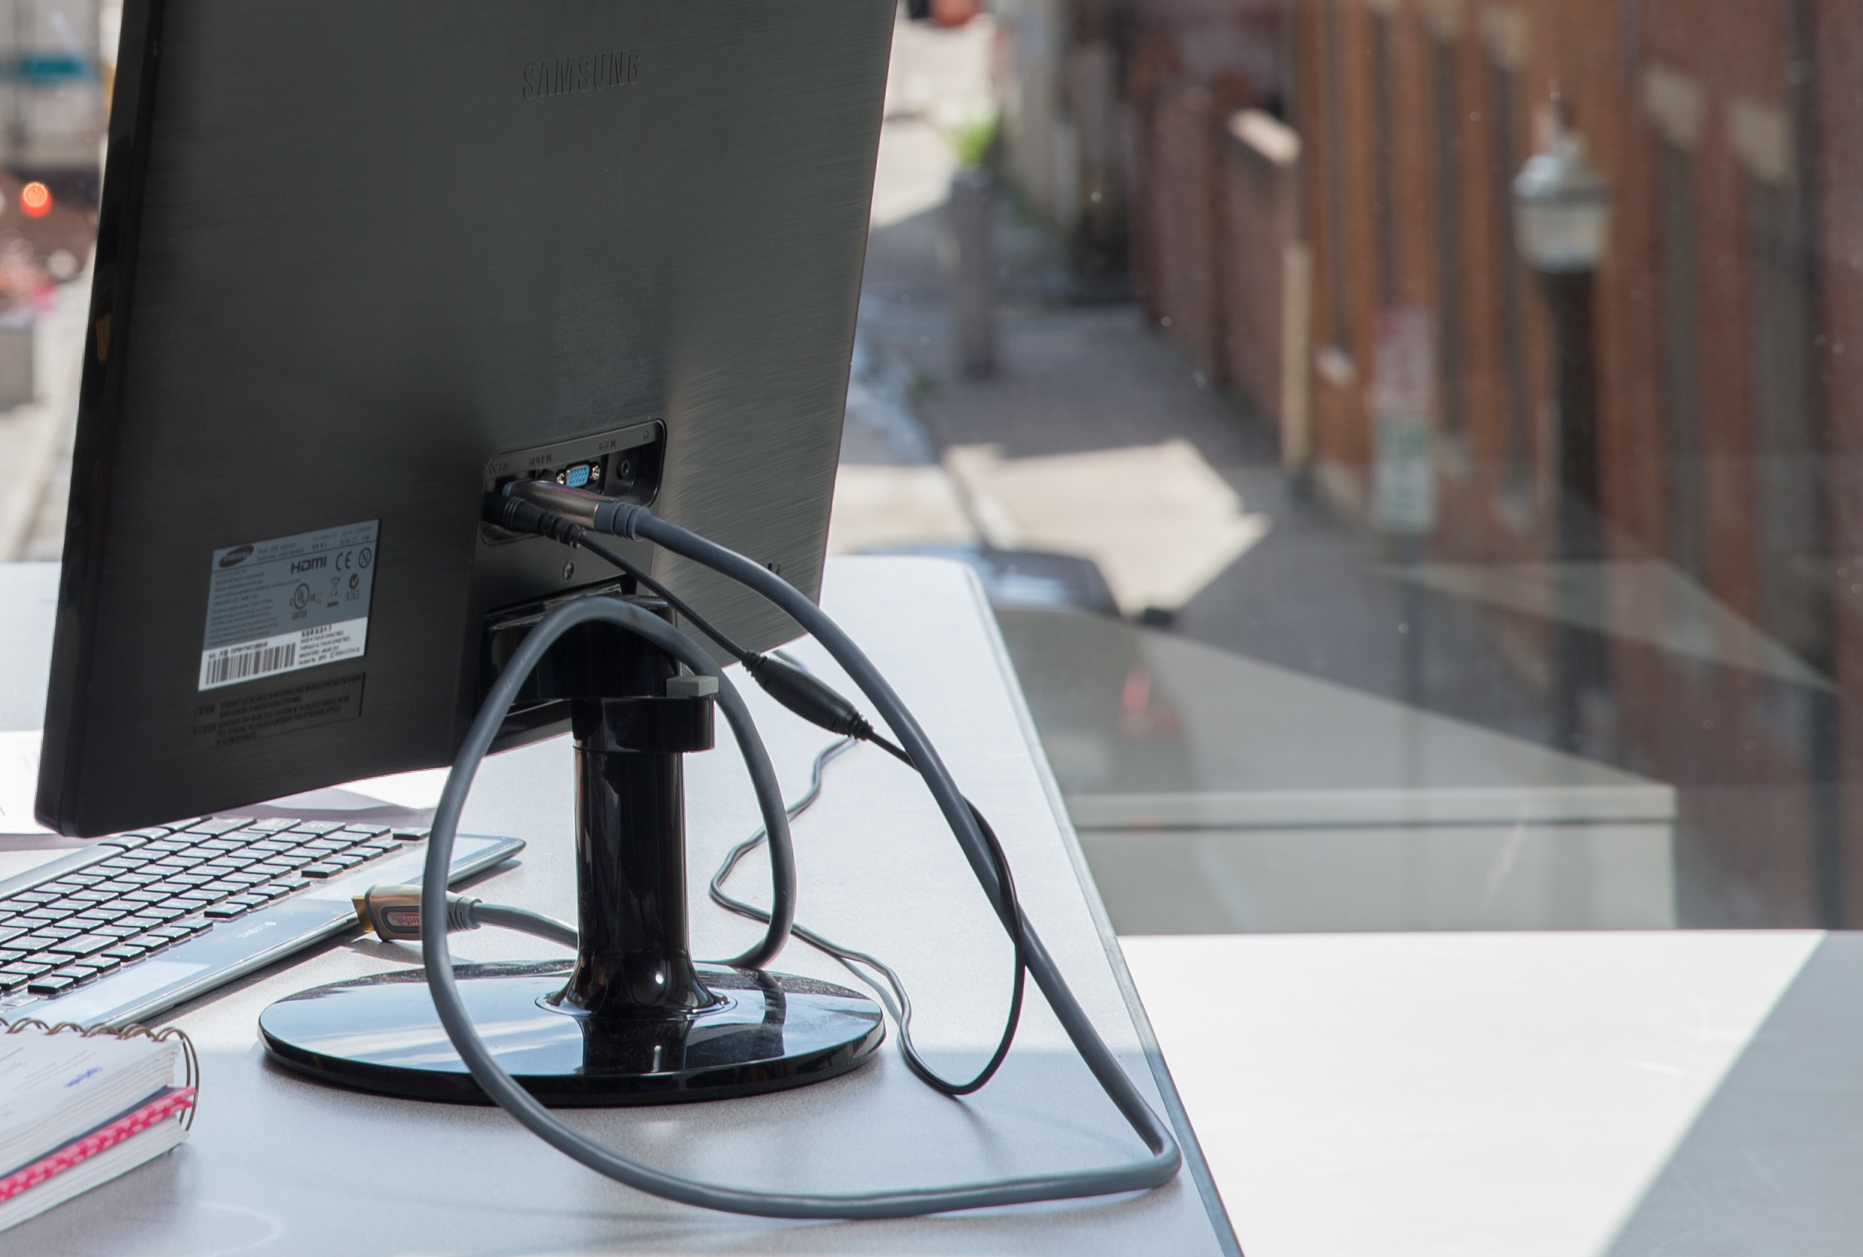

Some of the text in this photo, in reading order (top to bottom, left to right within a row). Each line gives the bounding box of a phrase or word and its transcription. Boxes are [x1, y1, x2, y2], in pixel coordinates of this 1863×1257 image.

[523, 49, 642, 101] SAMSUNG
[291, 556, 327, 574] HDMI
[335, 550, 352, 571] CE
